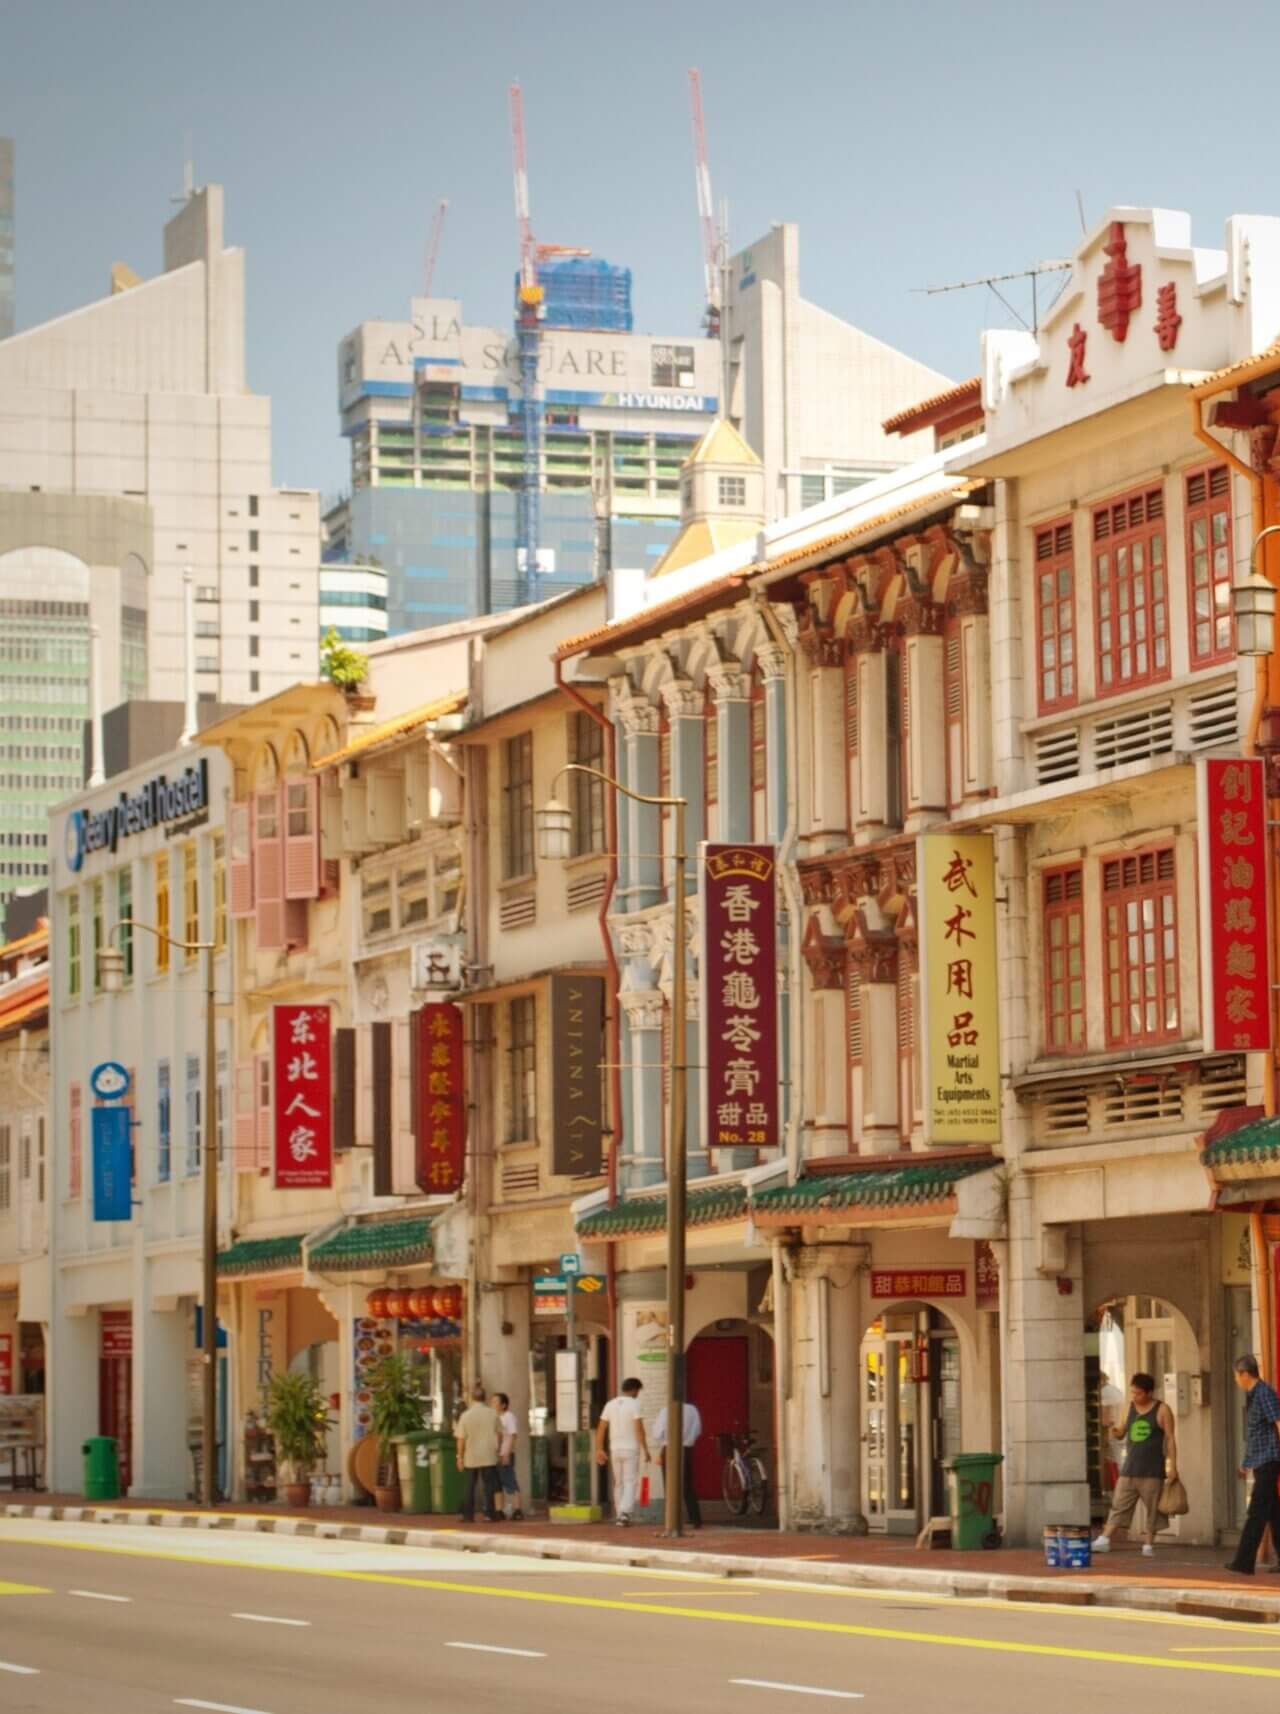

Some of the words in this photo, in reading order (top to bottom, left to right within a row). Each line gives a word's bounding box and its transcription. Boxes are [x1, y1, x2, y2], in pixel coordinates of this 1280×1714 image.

[618, 393, 703, 411] HYUNDAI
[942, 850, 979, 1049] 武术用品
[720, 884, 762, 1098] 香港龜苓膏
[947, 1054, 979, 1069] Martial
[284, 1010, 322, 1162] 东北人家
[955, 1071, 973, 1085] Arts
[937, 1086, 991, 1104] Equipments
[716, 1102, 768, 1126] 甜品
[747, 1131, 766, 1143] 28
